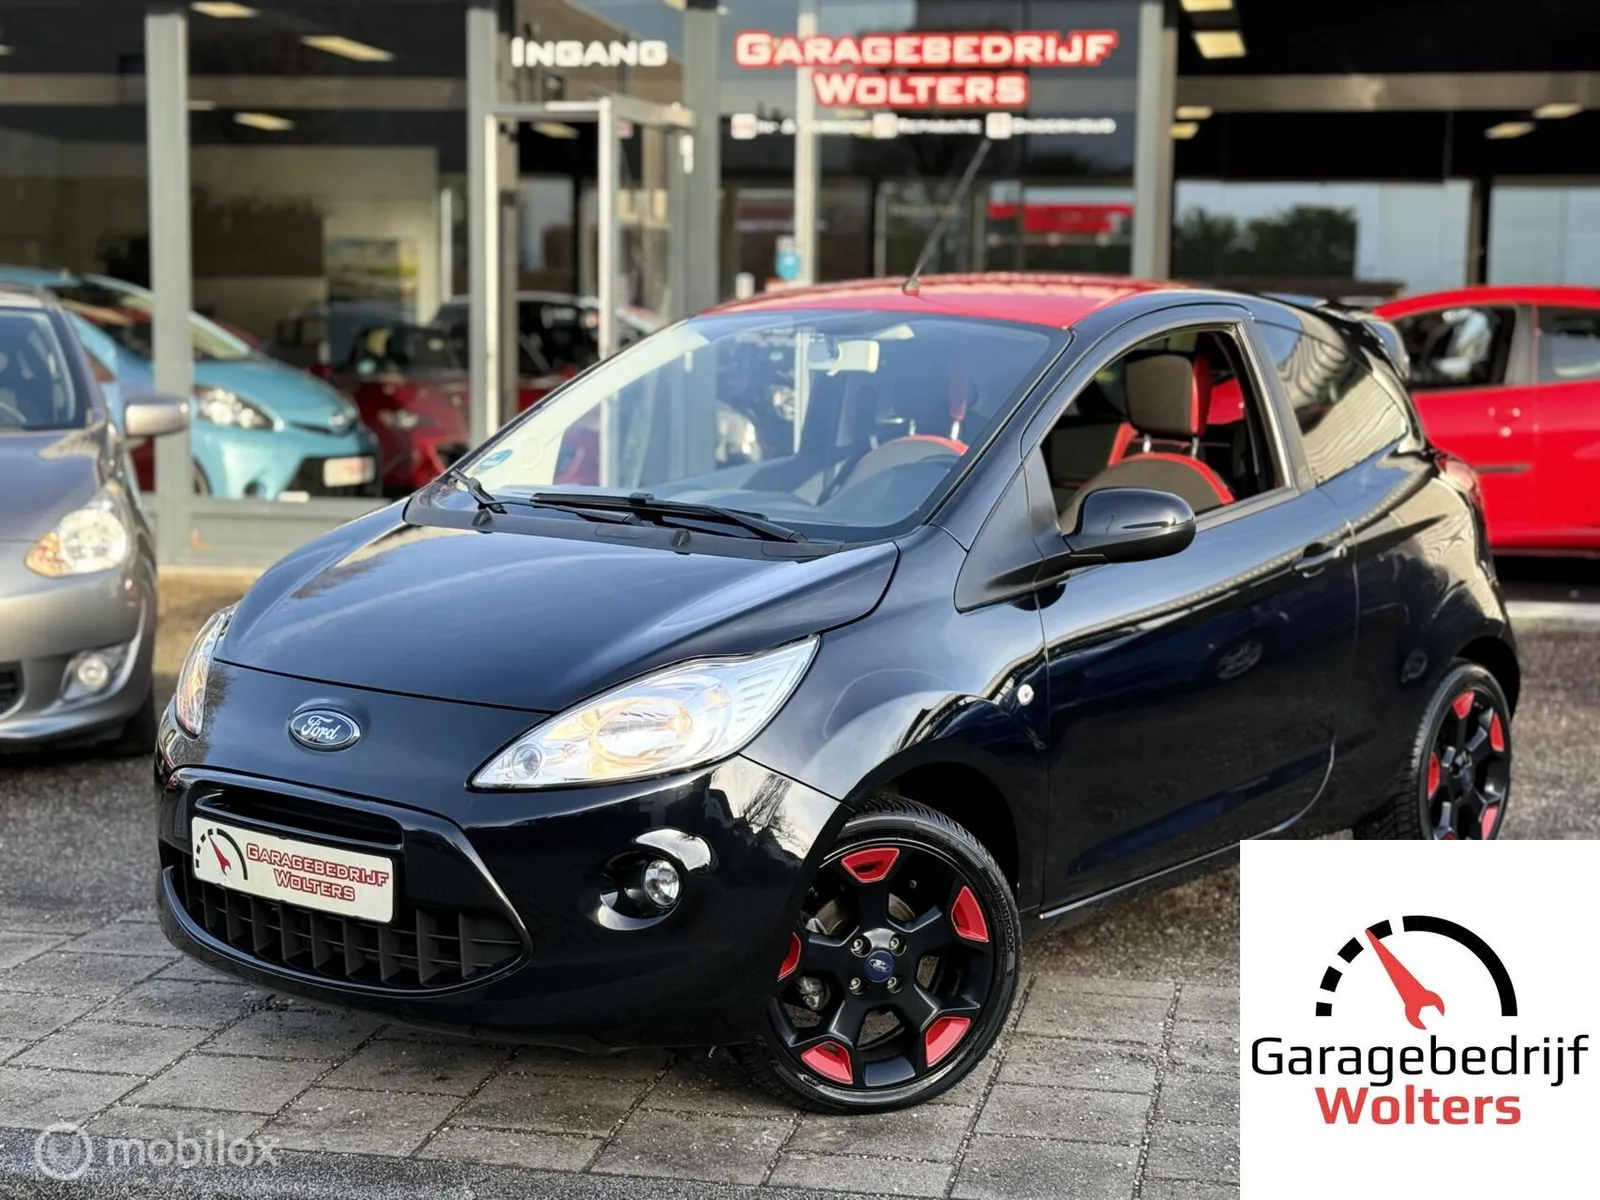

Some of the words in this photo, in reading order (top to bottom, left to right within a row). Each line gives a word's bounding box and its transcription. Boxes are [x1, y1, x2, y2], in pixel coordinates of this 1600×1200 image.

[511, 36, 668, 67] INGANG
[735, 30, 1118, 66] GARAGEBEDRIJF
[813, 72, 1029, 107] WOLTERS
[301, 715, 341, 740] Ford
[246, 843, 389, 887] GARAGEBEDRIJF
[274, 868, 355, 902] WOLTERS
